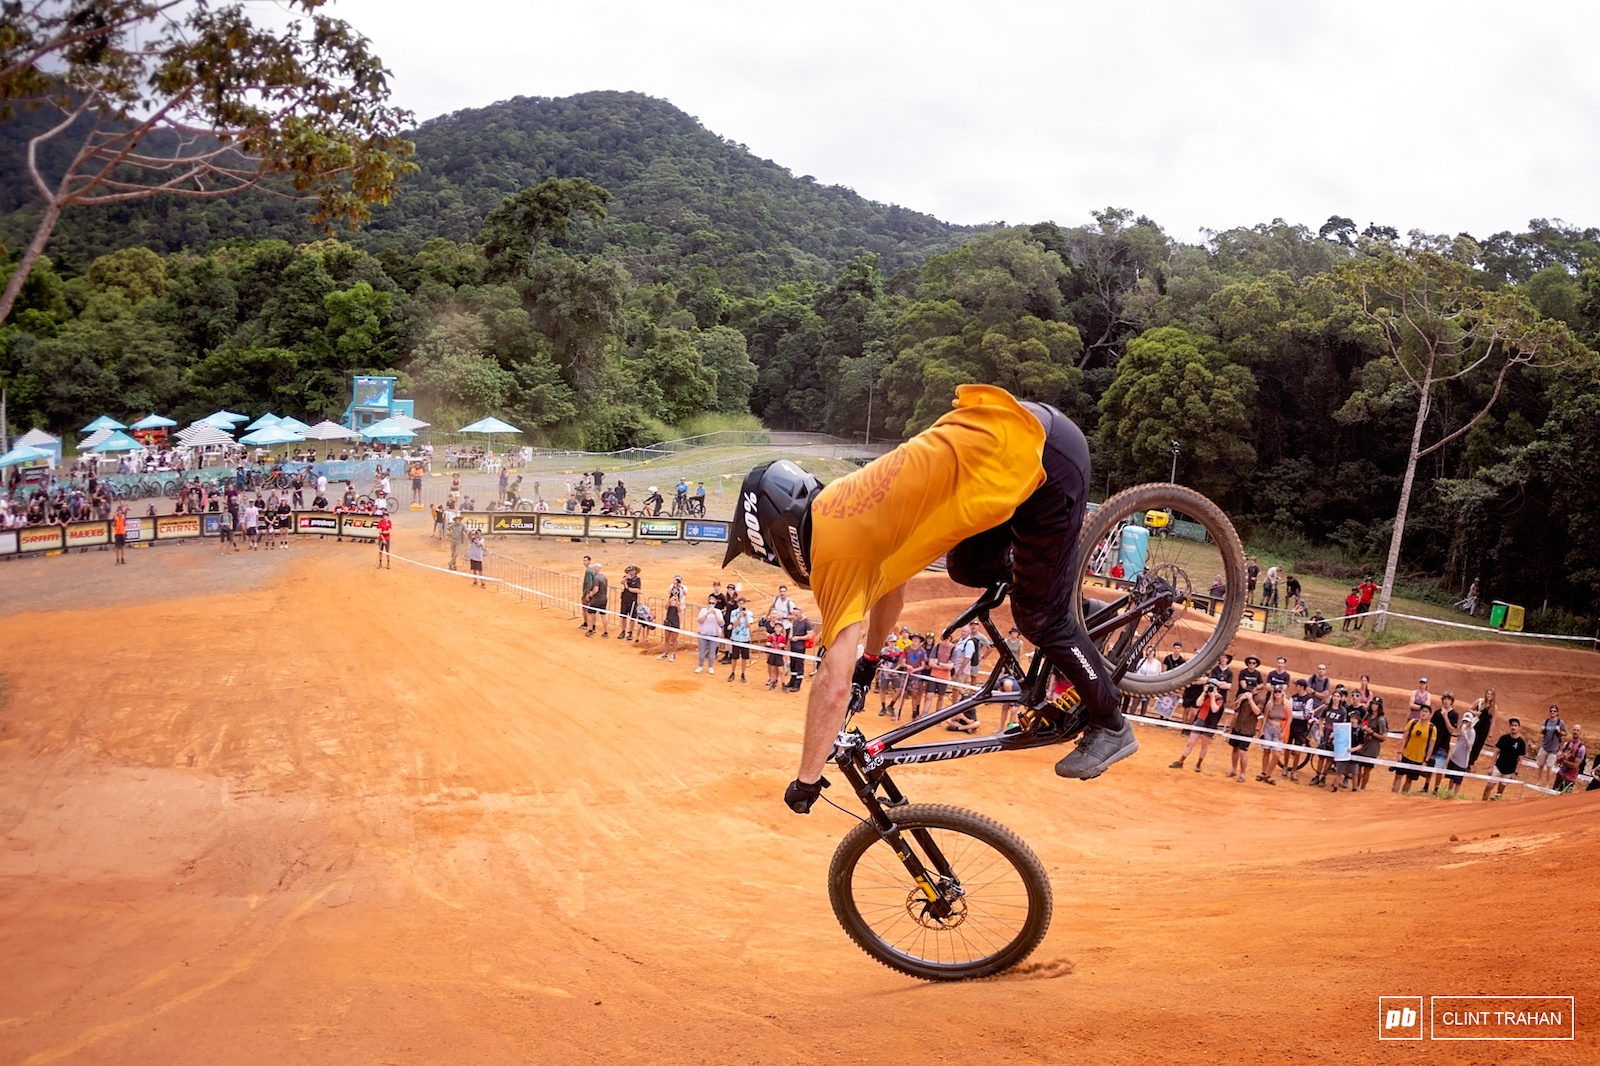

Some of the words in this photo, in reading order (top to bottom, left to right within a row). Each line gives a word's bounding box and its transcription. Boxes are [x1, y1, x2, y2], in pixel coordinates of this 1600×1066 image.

[159, 523, 199, 534] CAIRNS
[743, 491, 768, 556] 100%
[21, 533, 60, 544] SRAM
[69, 528, 105, 539] MAXXIS
[1325, 710, 1341, 720] FOX
[893, 745, 1003, 766] SPECIALIZED
